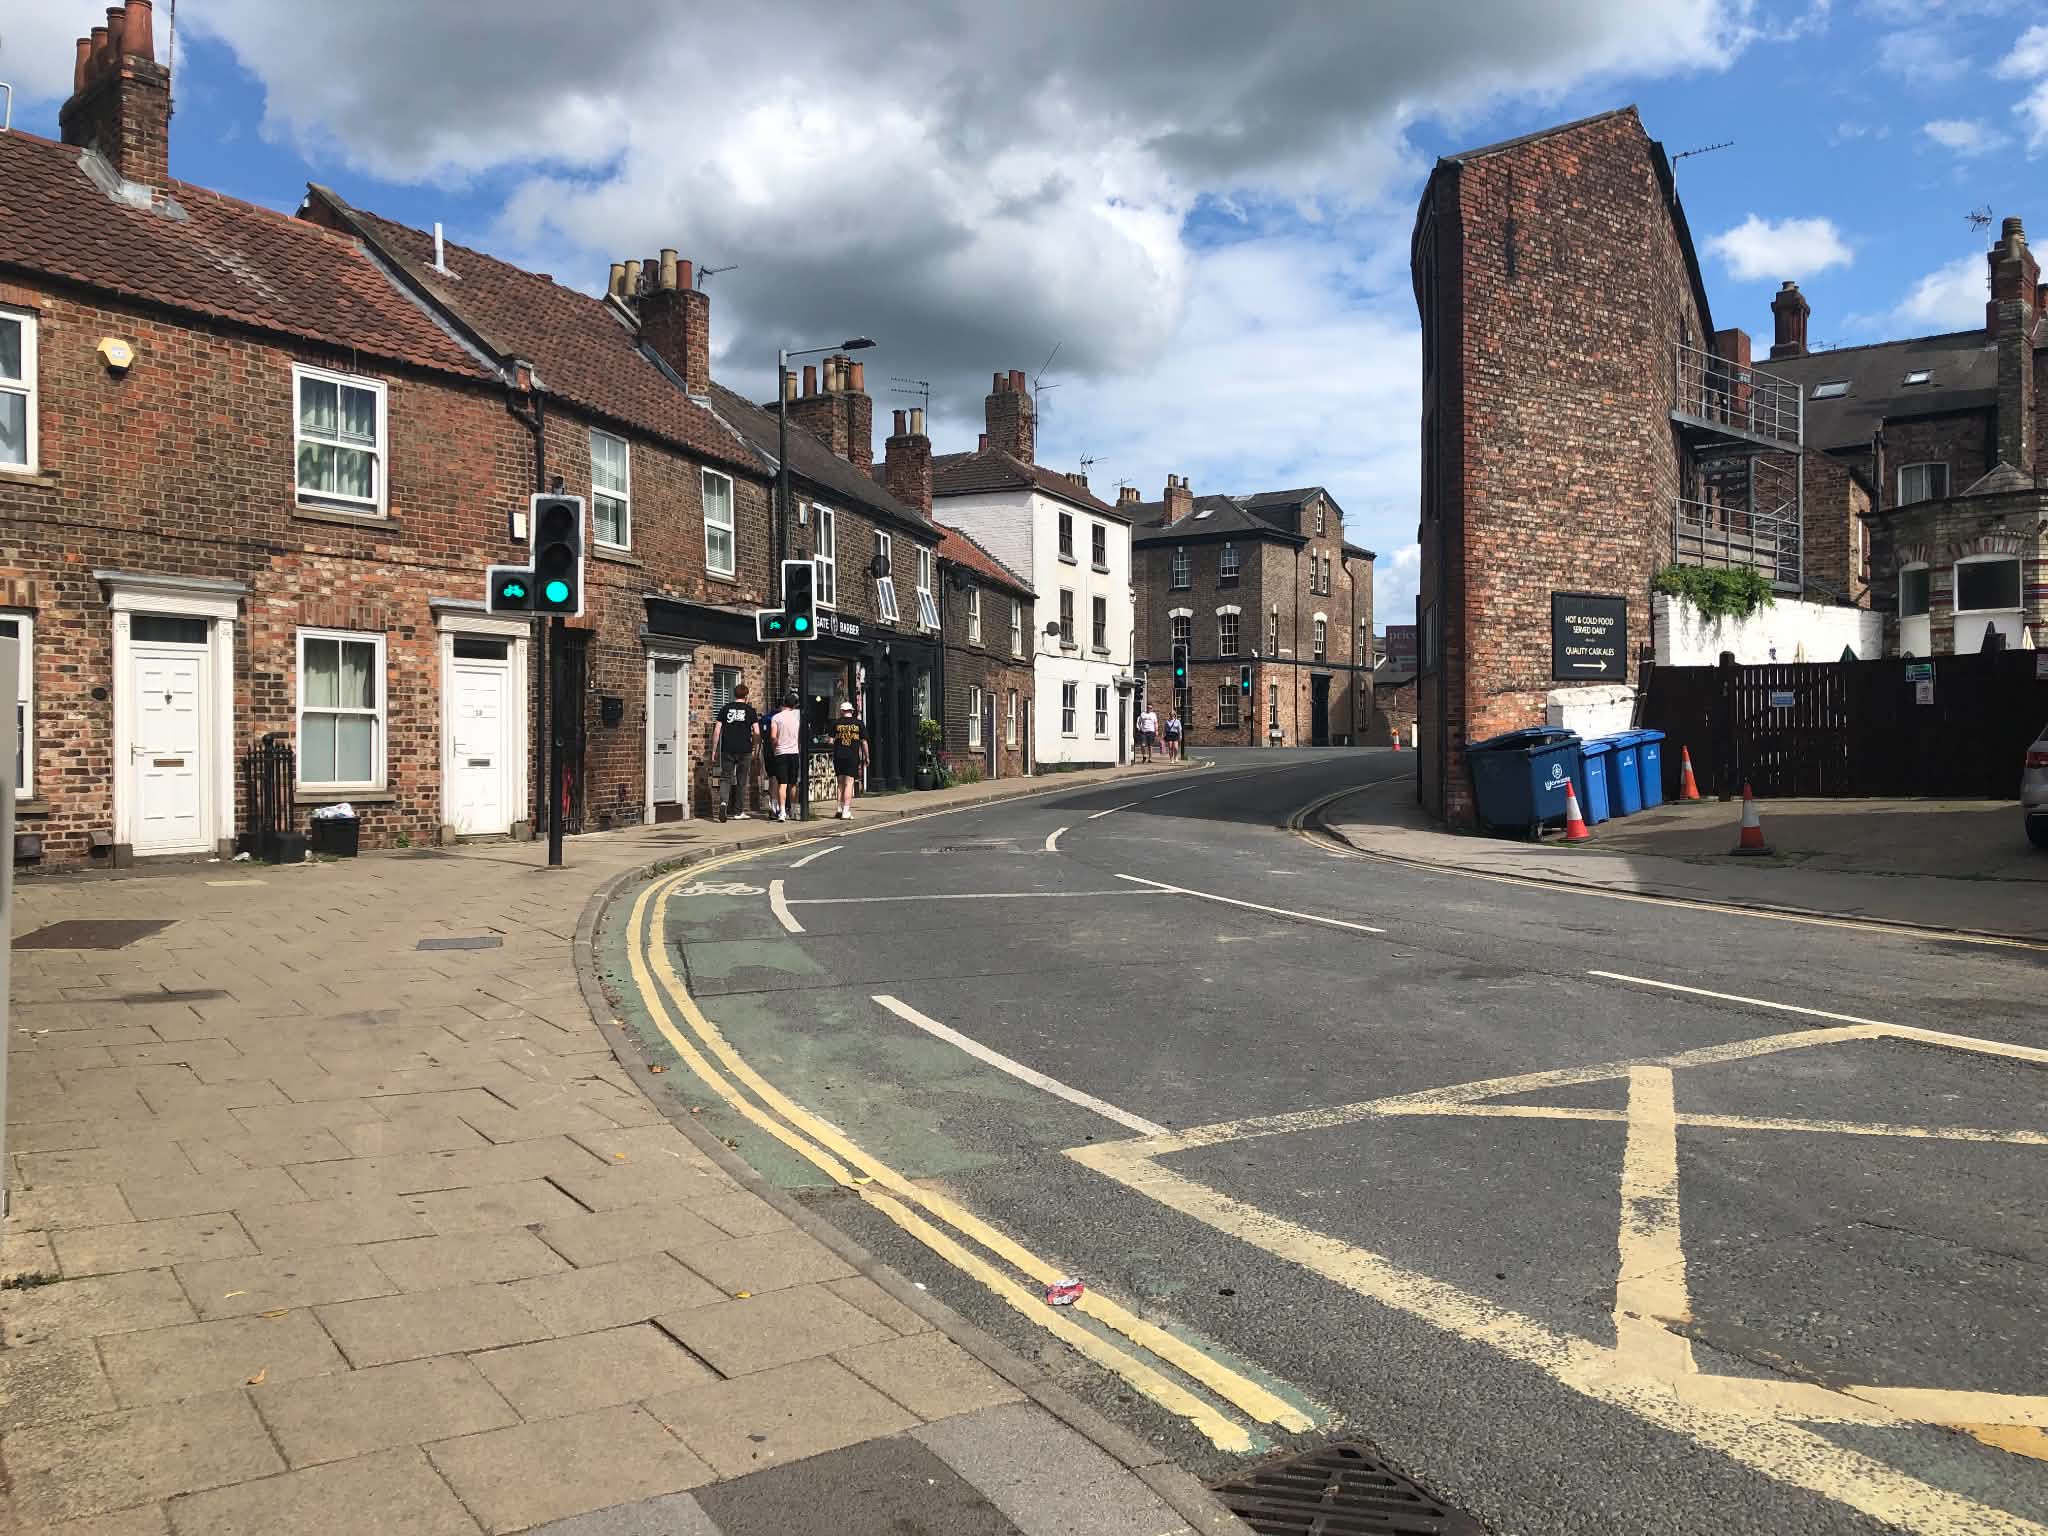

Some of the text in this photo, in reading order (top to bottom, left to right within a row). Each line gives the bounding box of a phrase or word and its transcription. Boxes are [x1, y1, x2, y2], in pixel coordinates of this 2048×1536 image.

[1565, 615, 1577, 624] HOT
[1582, 616, 1598, 625] COLD
[1598, 617, 1614, 626] FOOD
[839, 621, 860, 635] BARBER
[1573, 625, 1606, 635] SERVED DAILY
[1565, 646, 1615, 656] QUALITY CASK ALES
